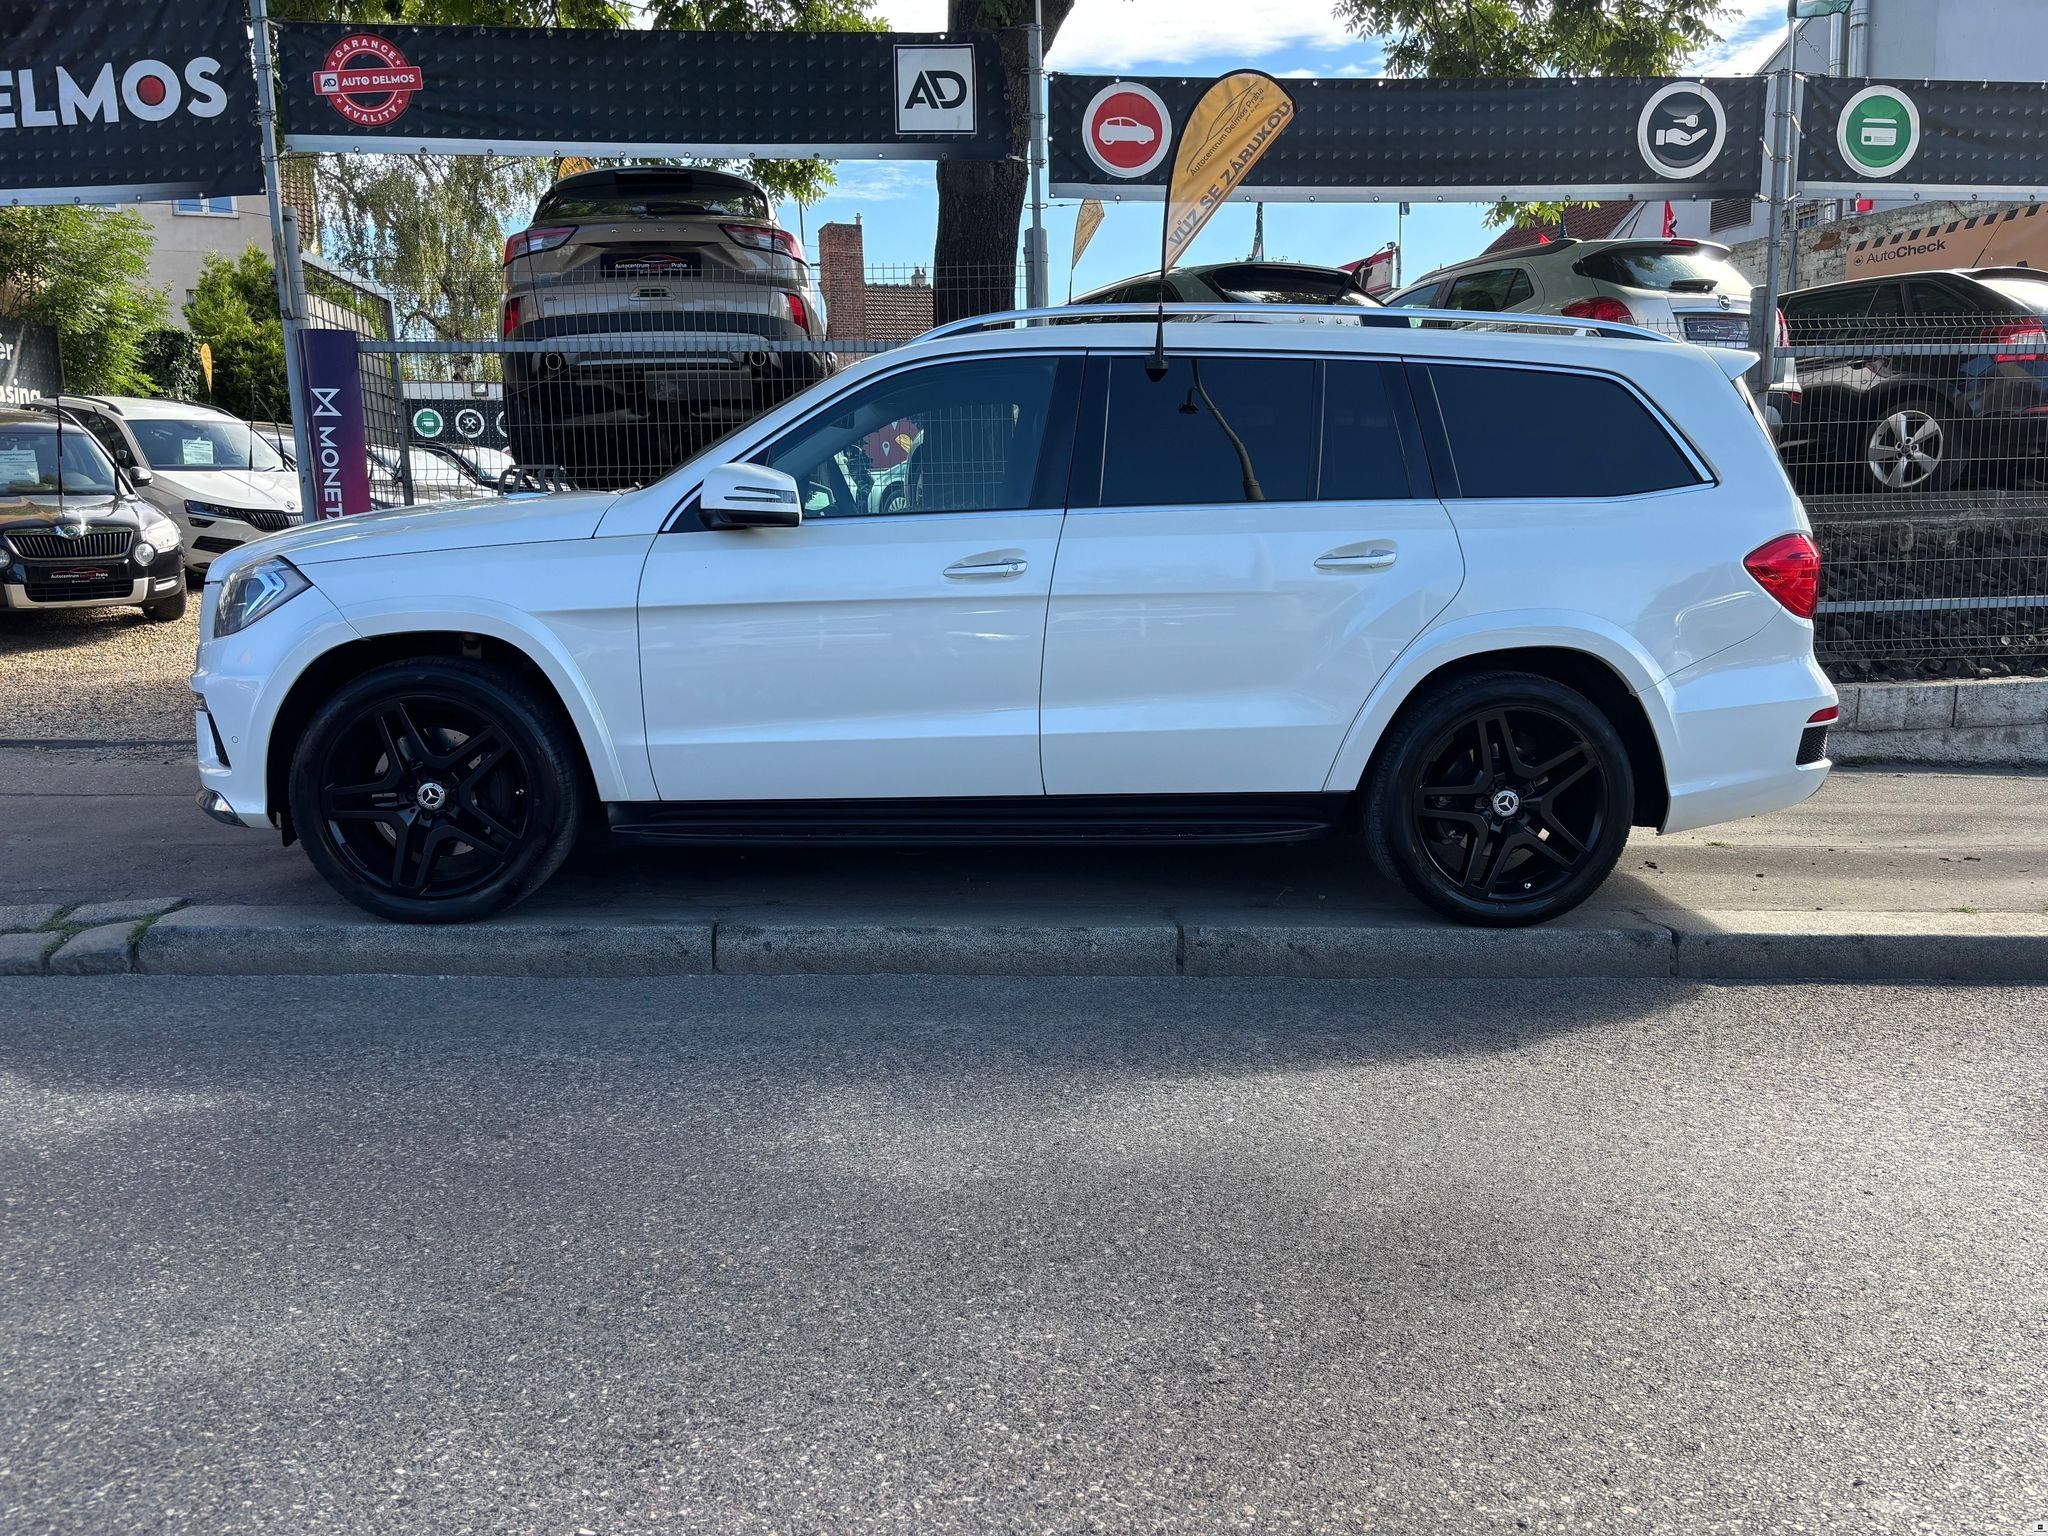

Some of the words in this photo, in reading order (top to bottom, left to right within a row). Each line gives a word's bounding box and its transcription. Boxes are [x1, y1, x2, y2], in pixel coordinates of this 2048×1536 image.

[335, 38, 397, 60] GARANCE
[0, 56, 228, 129] ELMOS
[341, 76, 370, 87] AUTO
[372, 74, 415, 85] DELMOS
[904, 70, 967, 110] AD
[343, 104, 398, 122] KVALITY
[1190, 133, 1228, 176] Autocentrum
[1224, 107, 1248, 134] Delmos
[1245, 87, 1264, 108] Praha
[1168, 208, 1203, 244] VŮZ
[1200, 184, 1223, 210] SE
[1220, 101, 1293, 186] ZÁRUKOU
[1866, 239, 1946, 264] AutoCheck
[319, 426, 343, 519] MONET
